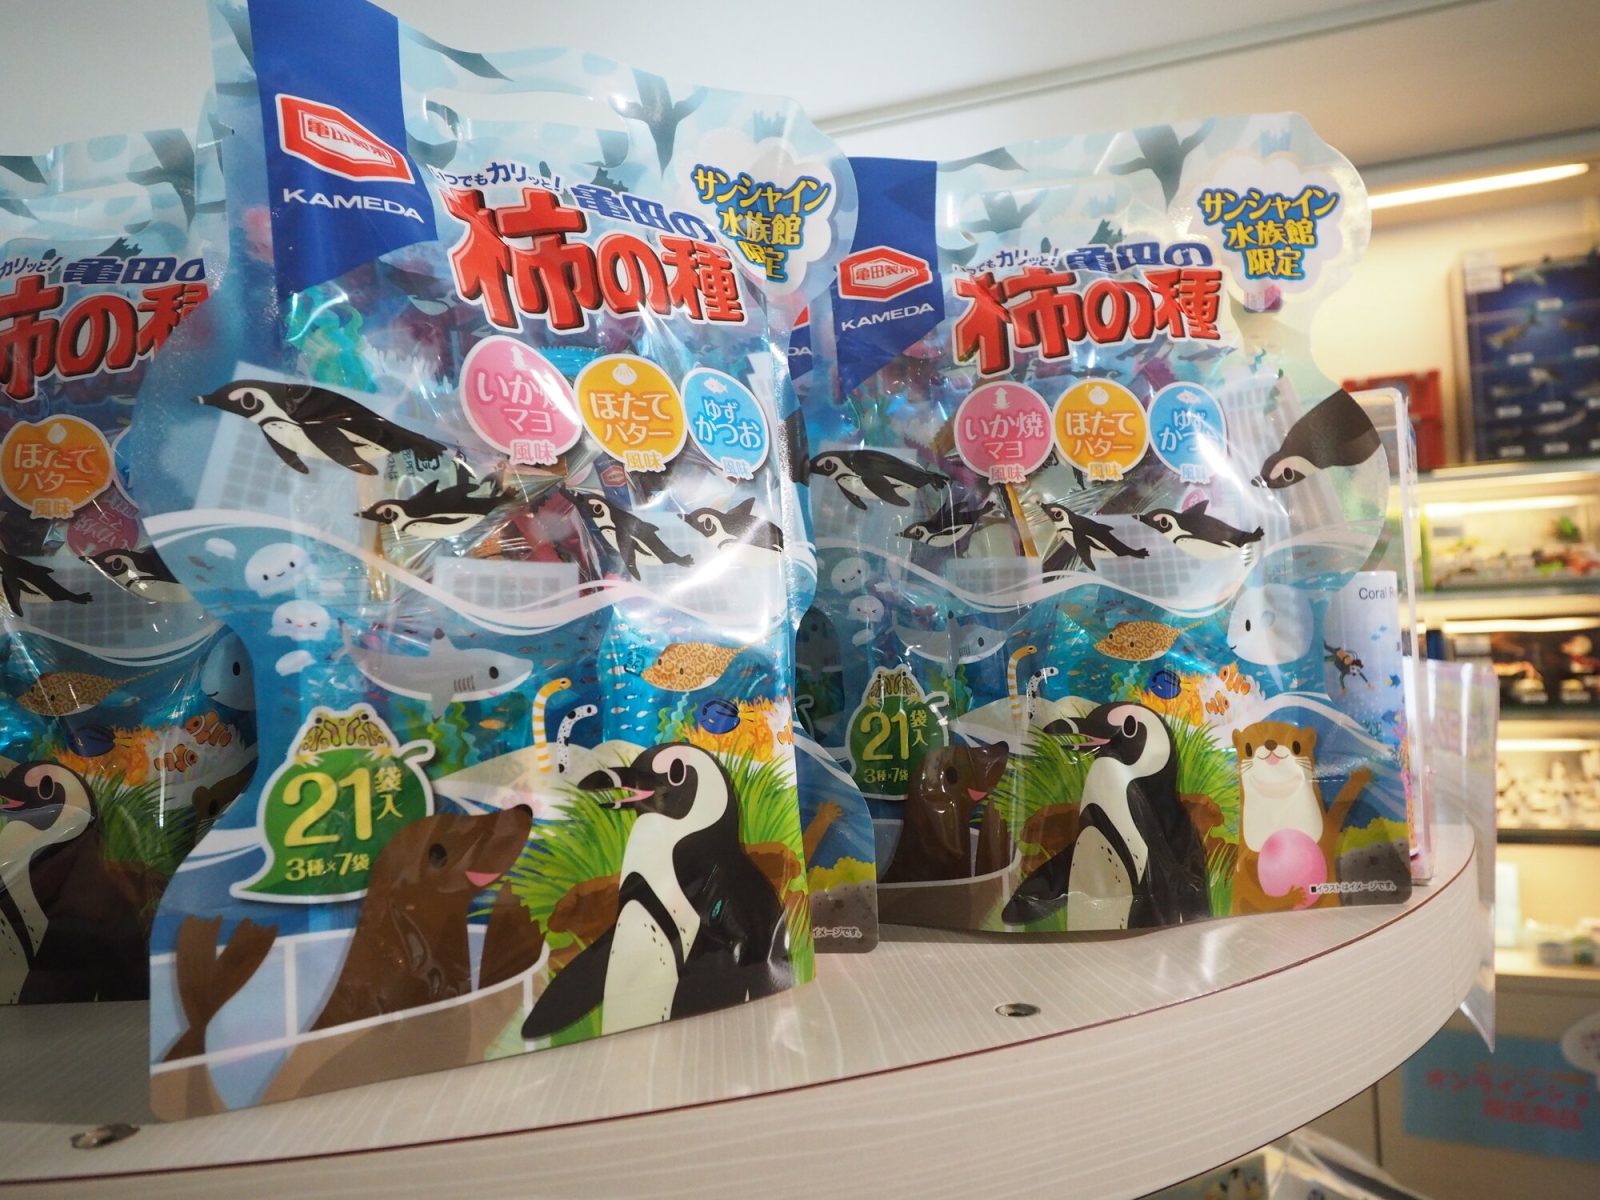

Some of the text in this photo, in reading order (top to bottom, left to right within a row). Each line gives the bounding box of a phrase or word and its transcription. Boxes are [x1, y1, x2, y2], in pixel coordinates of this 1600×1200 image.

[694, 168, 829, 213] サンシャイン
[1201, 188, 1337, 222] サンシャイン
[283, 188, 424, 223] KAMEDA
[571, 184, 717, 242] 亀田の
[719, 206, 801, 245] 水族館
[1226, 219, 1316, 249] 水族館
[441, 187, 745, 329] 柿の種
[1066, 242, 1213, 273] 亀田の
[1245, 248, 1305, 277] 限定
[841, 303, 935, 331] KAMEDA
[955, 267, 1222, 374] 柿の種
[503, 408, 552, 433] マヨ
[590, 392, 671, 421] ほたて
[703, 399, 738, 423] ゆず
[605, 421, 672, 445] バター
[696, 414, 761, 449] かつお
[966, 411, 1045, 440] いか焼
[1066, 411, 1135, 436] ほたて
[15, 444, 97, 474] ほたて
[513, 442, 554, 461] 風味
[625, 452, 661, 470] 風味
[984, 441, 1023, 459] マヨ
[1073, 437, 1133, 457] バター
[17, 471, 90, 493] バター
[989, 464, 1025, 482] 風味
[1088, 463, 1122, 479] 風味
[1358, 586, 1387, 600] Coral
[861, 711, 909, 761] 21
[910, 708, 929, 747] 袋入
[282, 767, 373, 847] 21
[375, 765, 403, 820] 袋入
